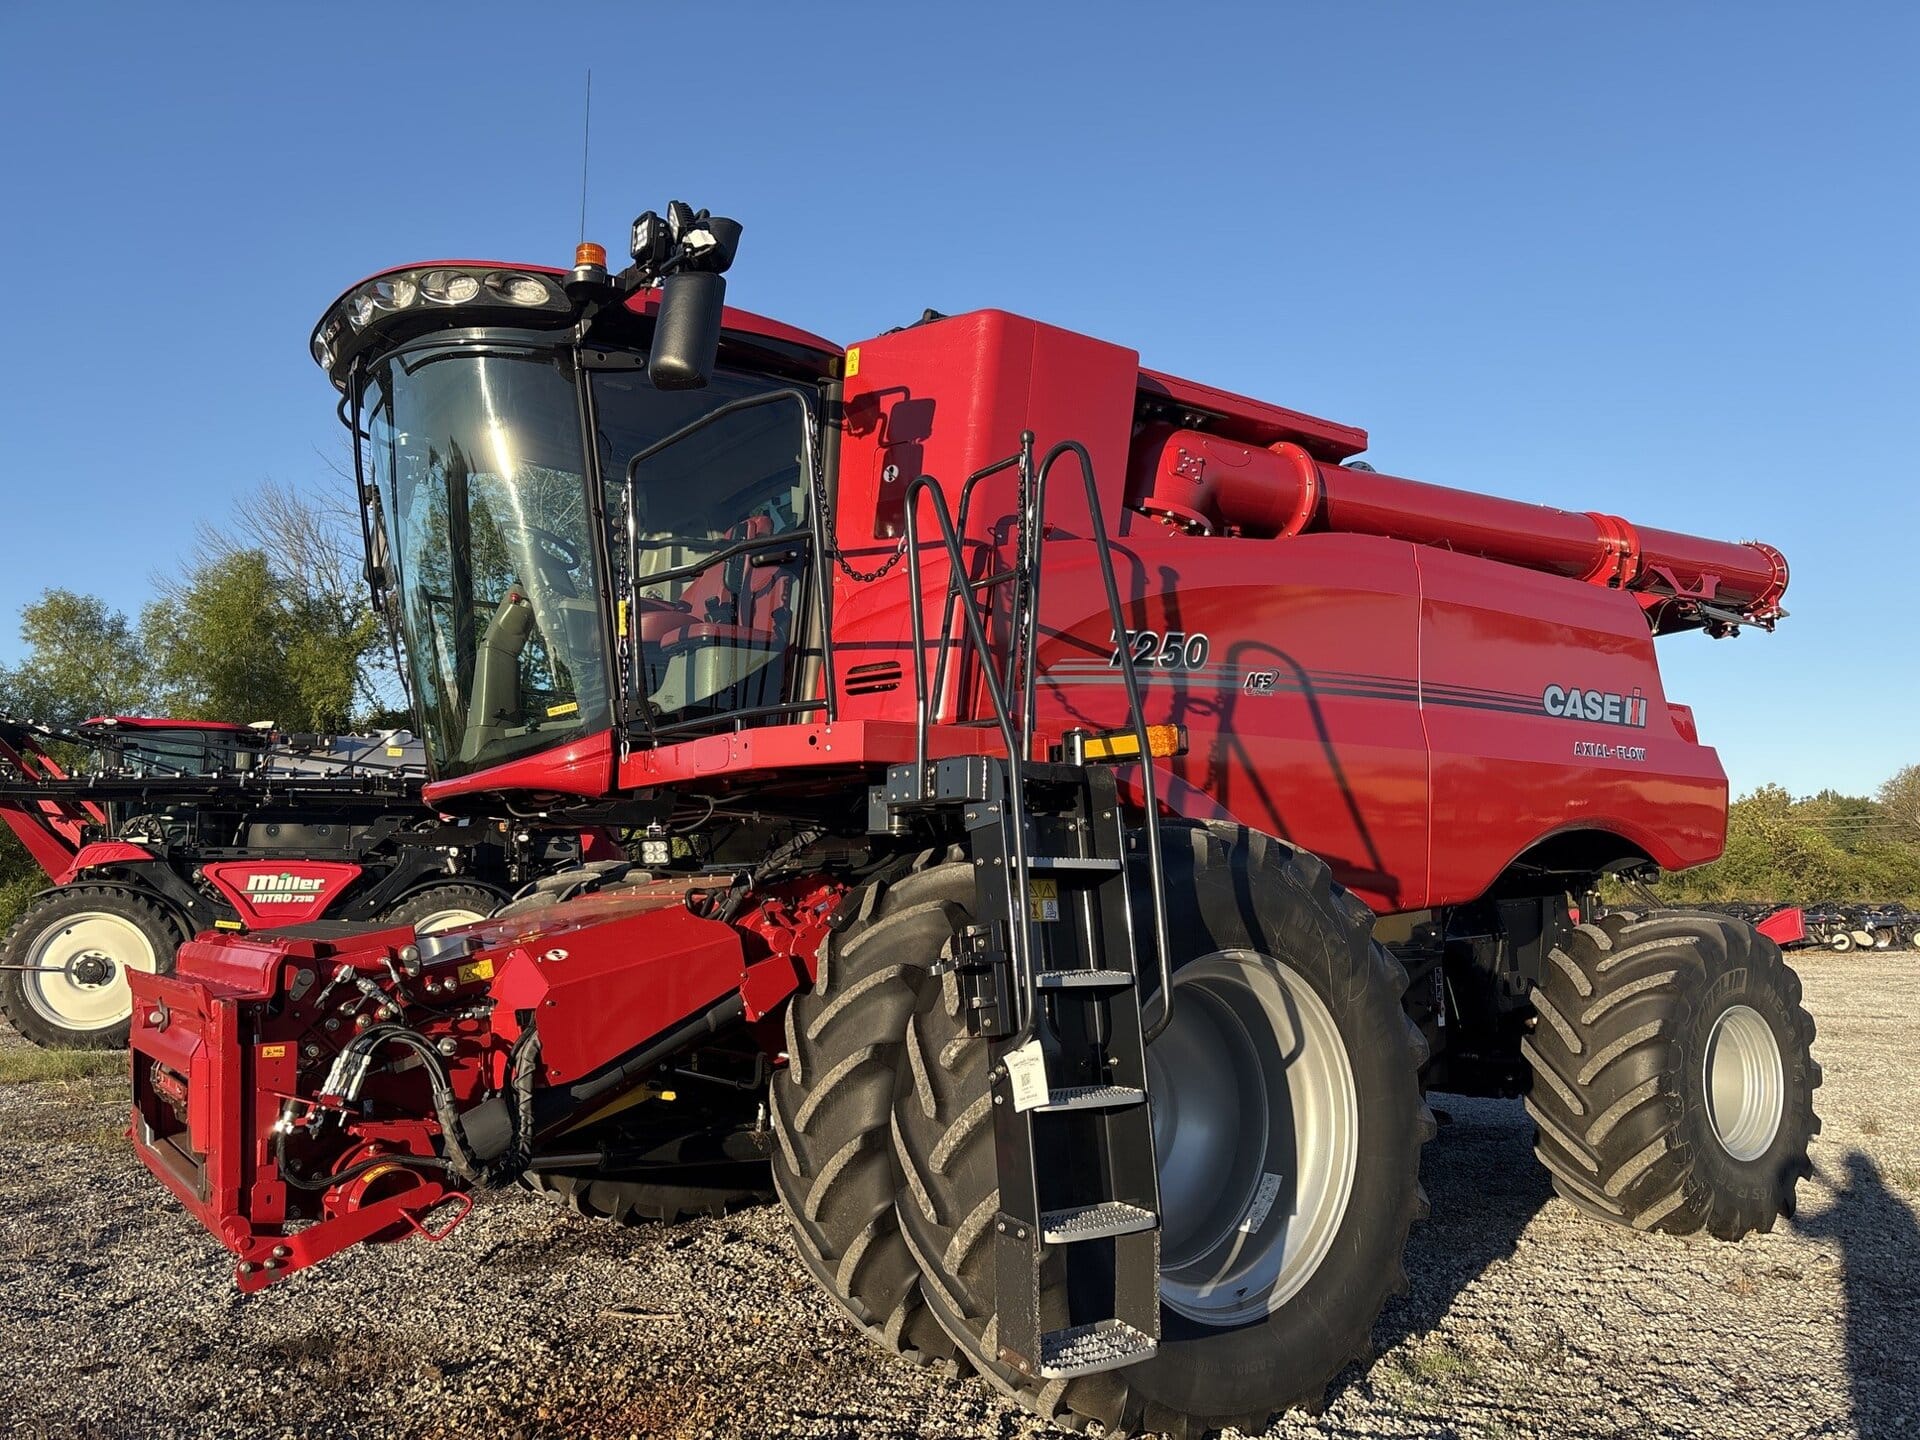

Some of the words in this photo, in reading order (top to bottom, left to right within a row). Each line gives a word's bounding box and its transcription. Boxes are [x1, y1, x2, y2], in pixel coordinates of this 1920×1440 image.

[1109, 629, 1210, 672] 7250
[1244, 671, 1273, 689] AFS
[1543, 683, 1621, 724] CASE
[1574, 741, 1646, 761] AXIAL-FLOW
[252, 893, 293, 904] NITRO
